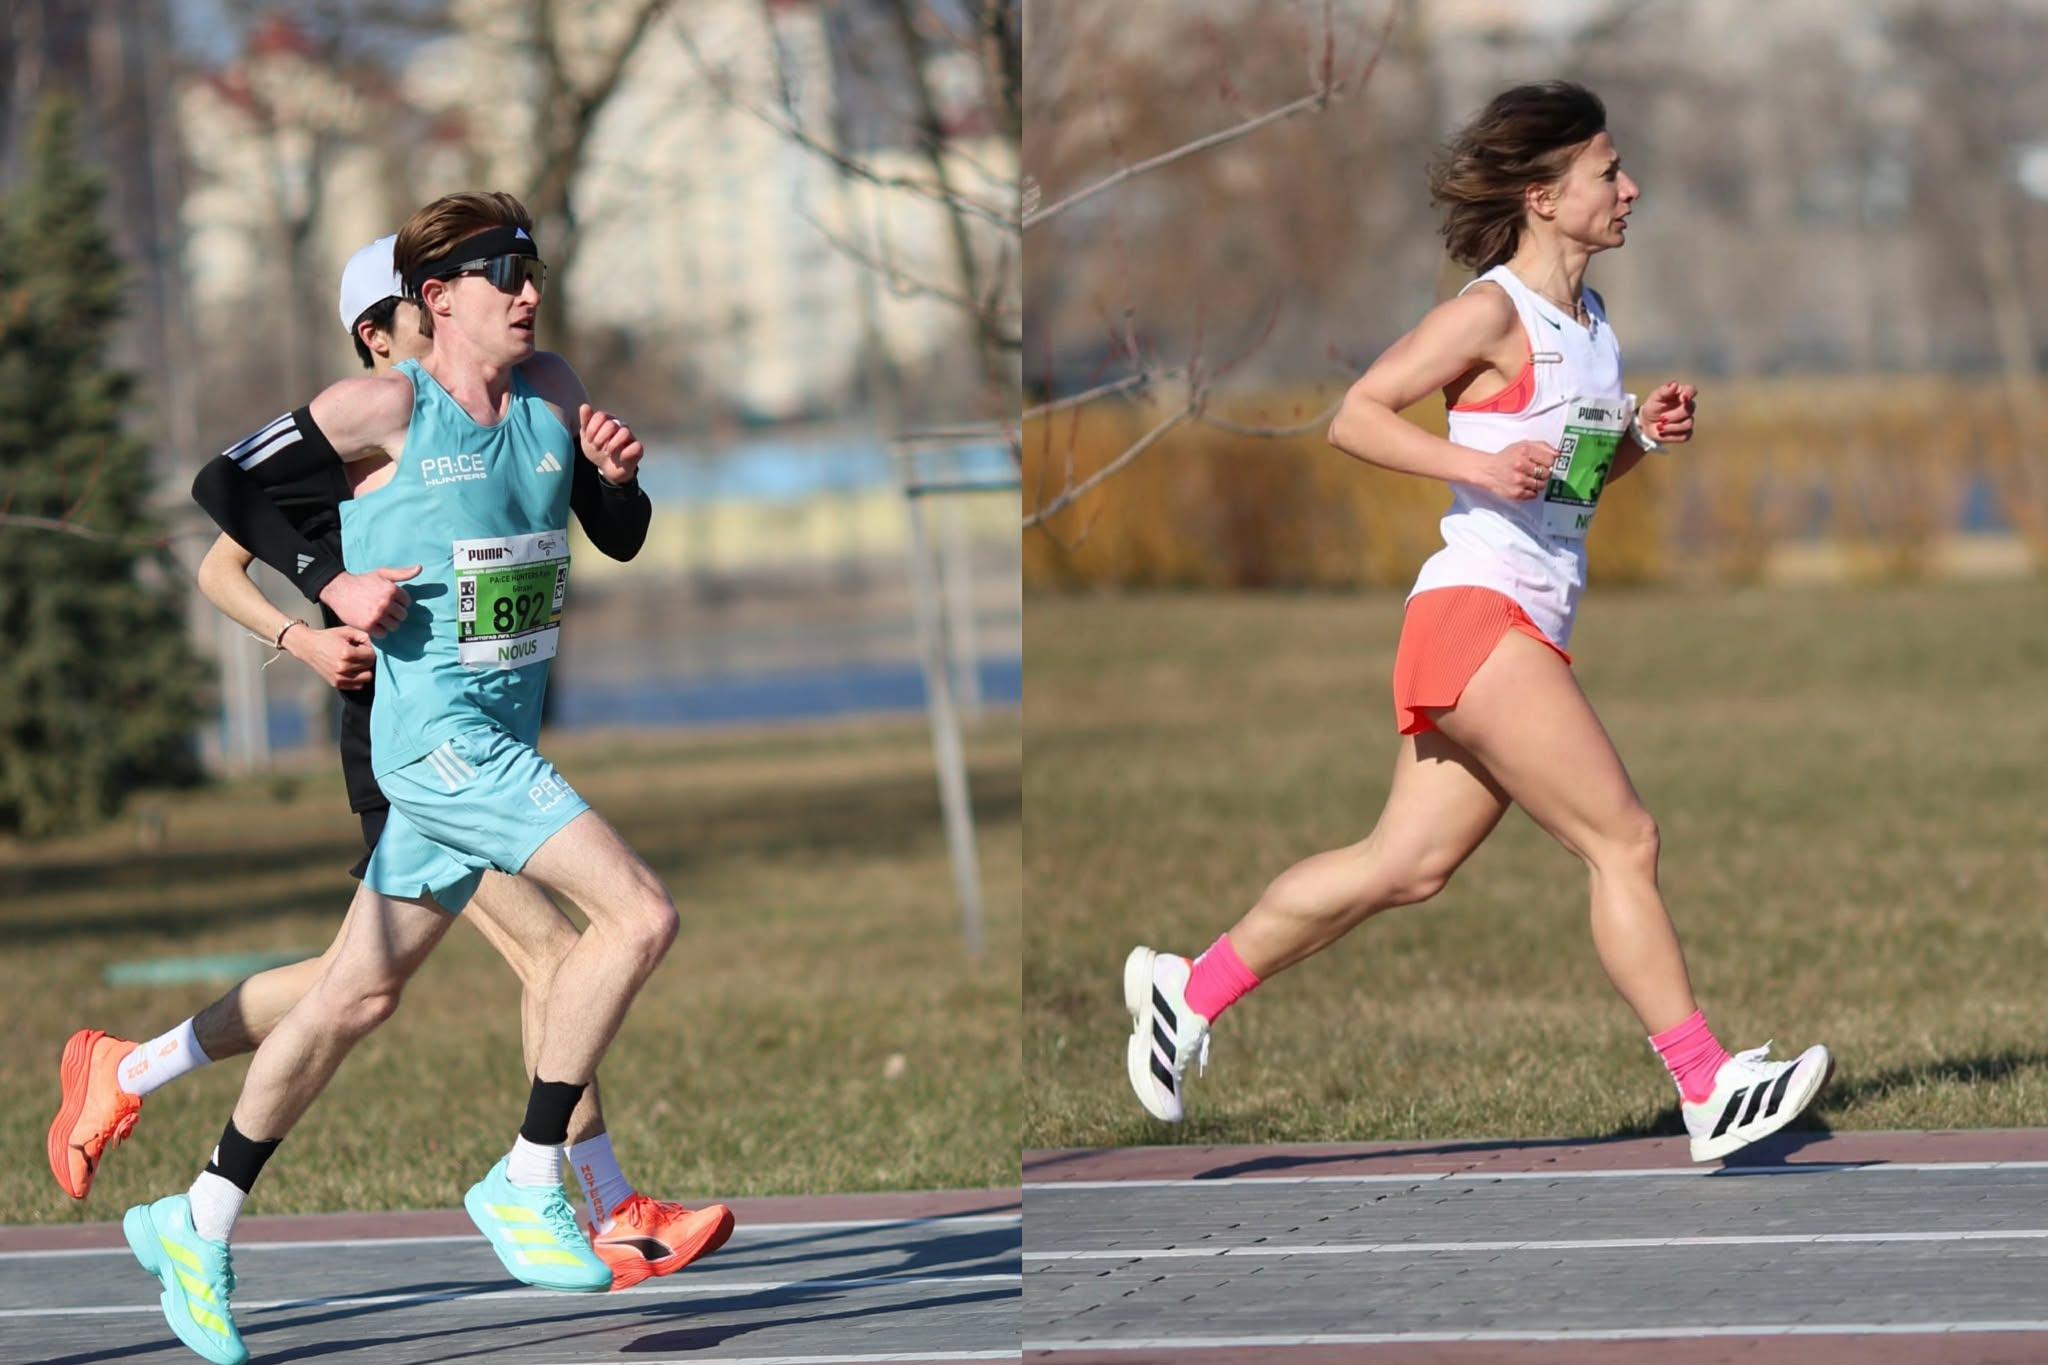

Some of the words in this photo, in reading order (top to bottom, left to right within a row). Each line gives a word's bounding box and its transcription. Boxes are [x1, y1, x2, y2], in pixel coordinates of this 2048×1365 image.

[1578, 406, 1605, 421] PUMA
[421, 453, 485, 479] PA:CE
[425, 472, 487, 487] HUNTERS
[468, 547, 503, 561] PUMA
[493, 592, 545, 633] 892
[498, 640, 537, 661] NOVUS
